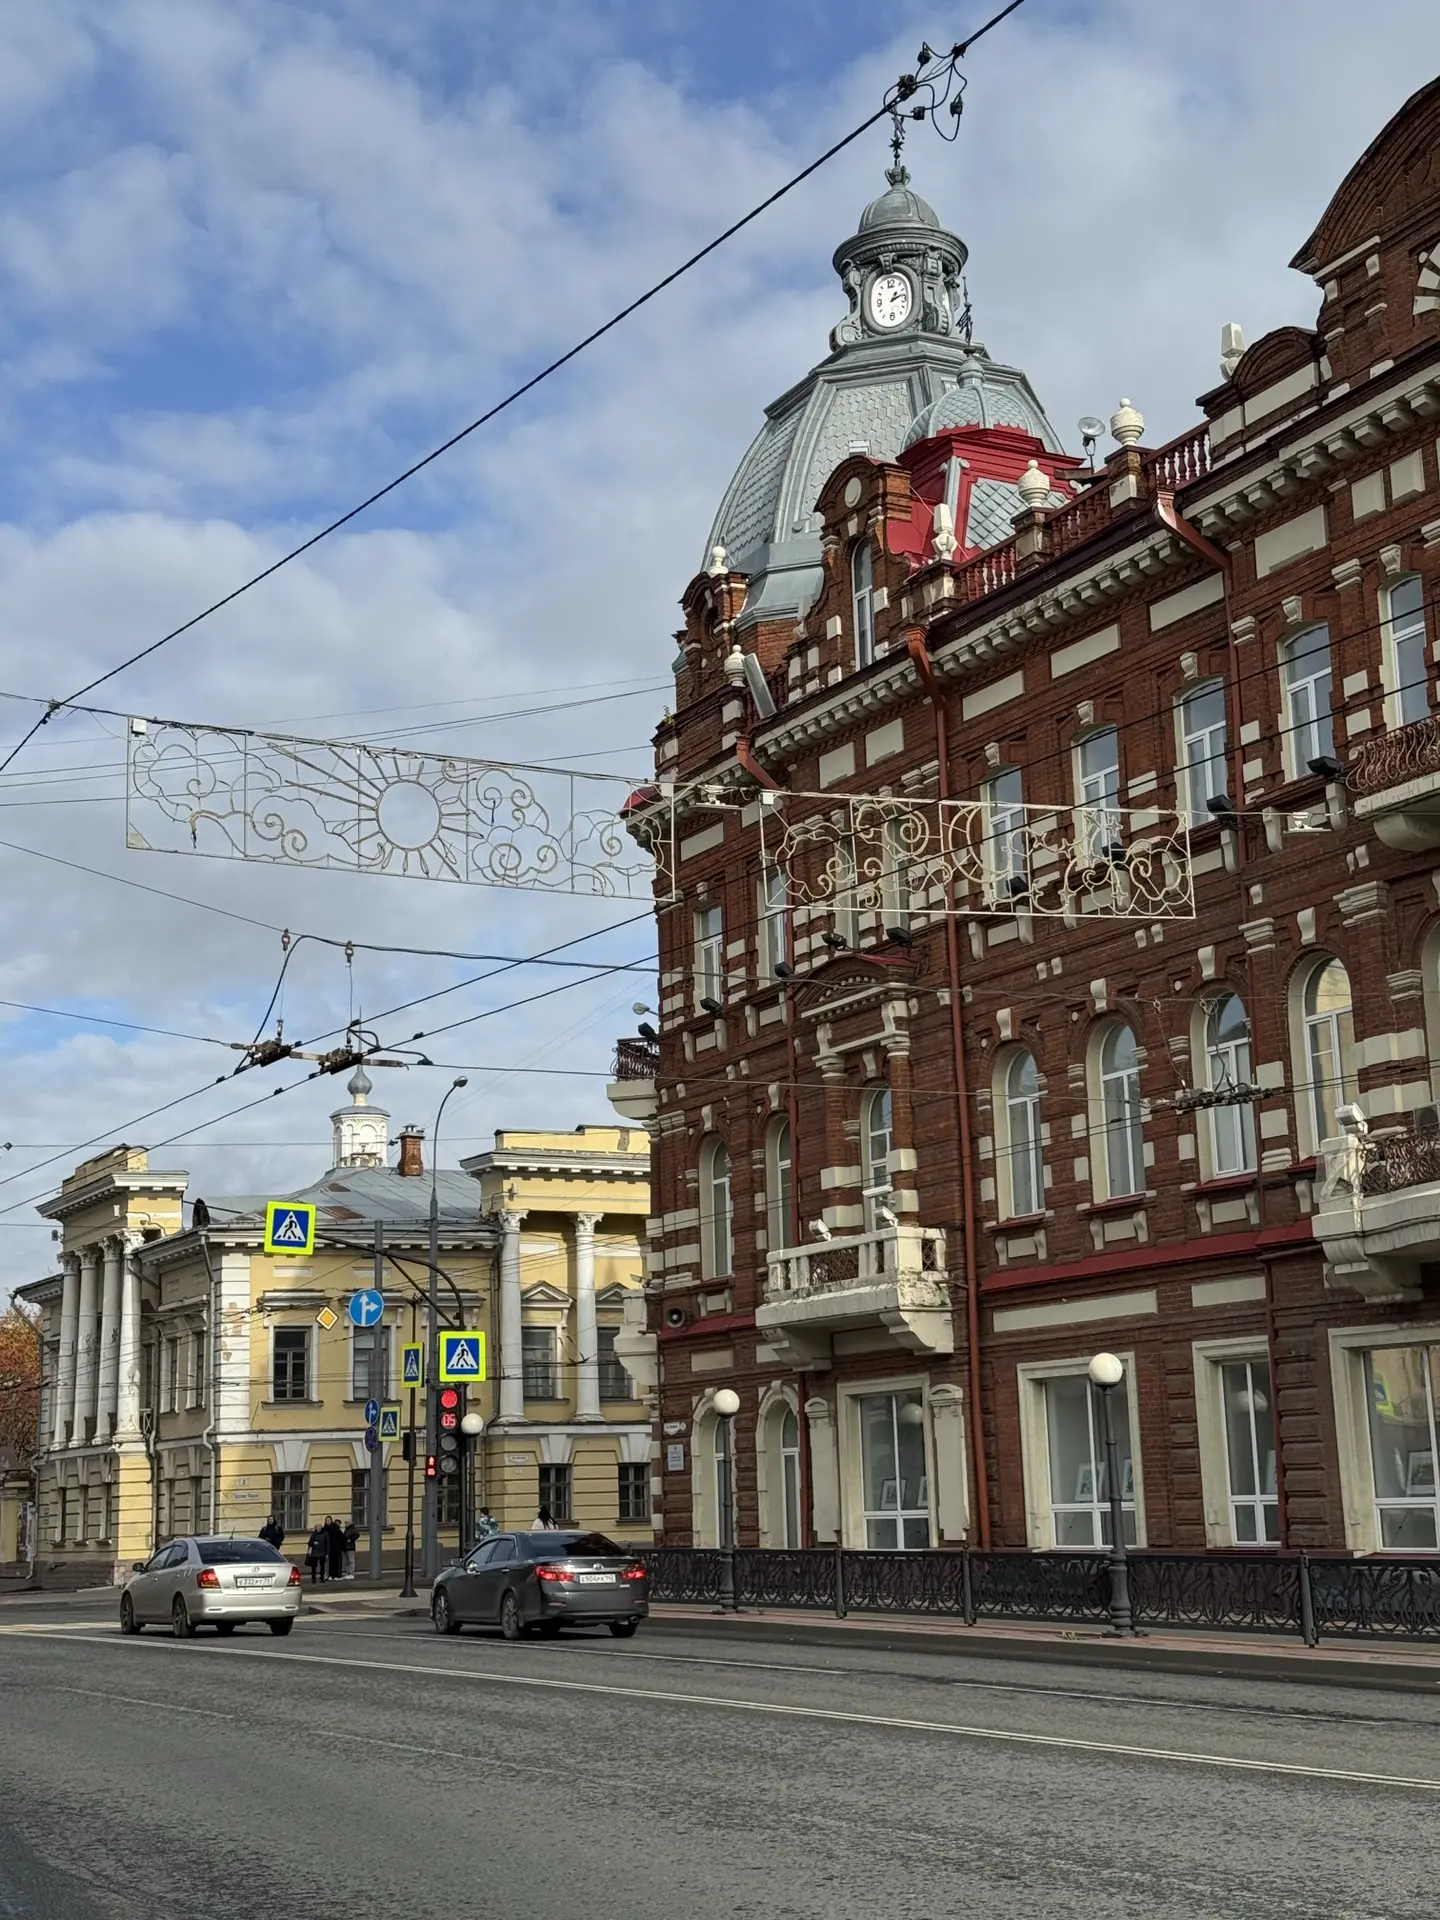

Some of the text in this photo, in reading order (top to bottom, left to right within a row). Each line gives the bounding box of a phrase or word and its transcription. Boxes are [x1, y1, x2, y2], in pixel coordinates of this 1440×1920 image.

[887, 279, 895, 288] 12
[877, 298, 882, 307] 9
[901, 294, 906, 303] 3
[890, 312, 895, 321] 6
[444, 1413, 456, 1427] 05
